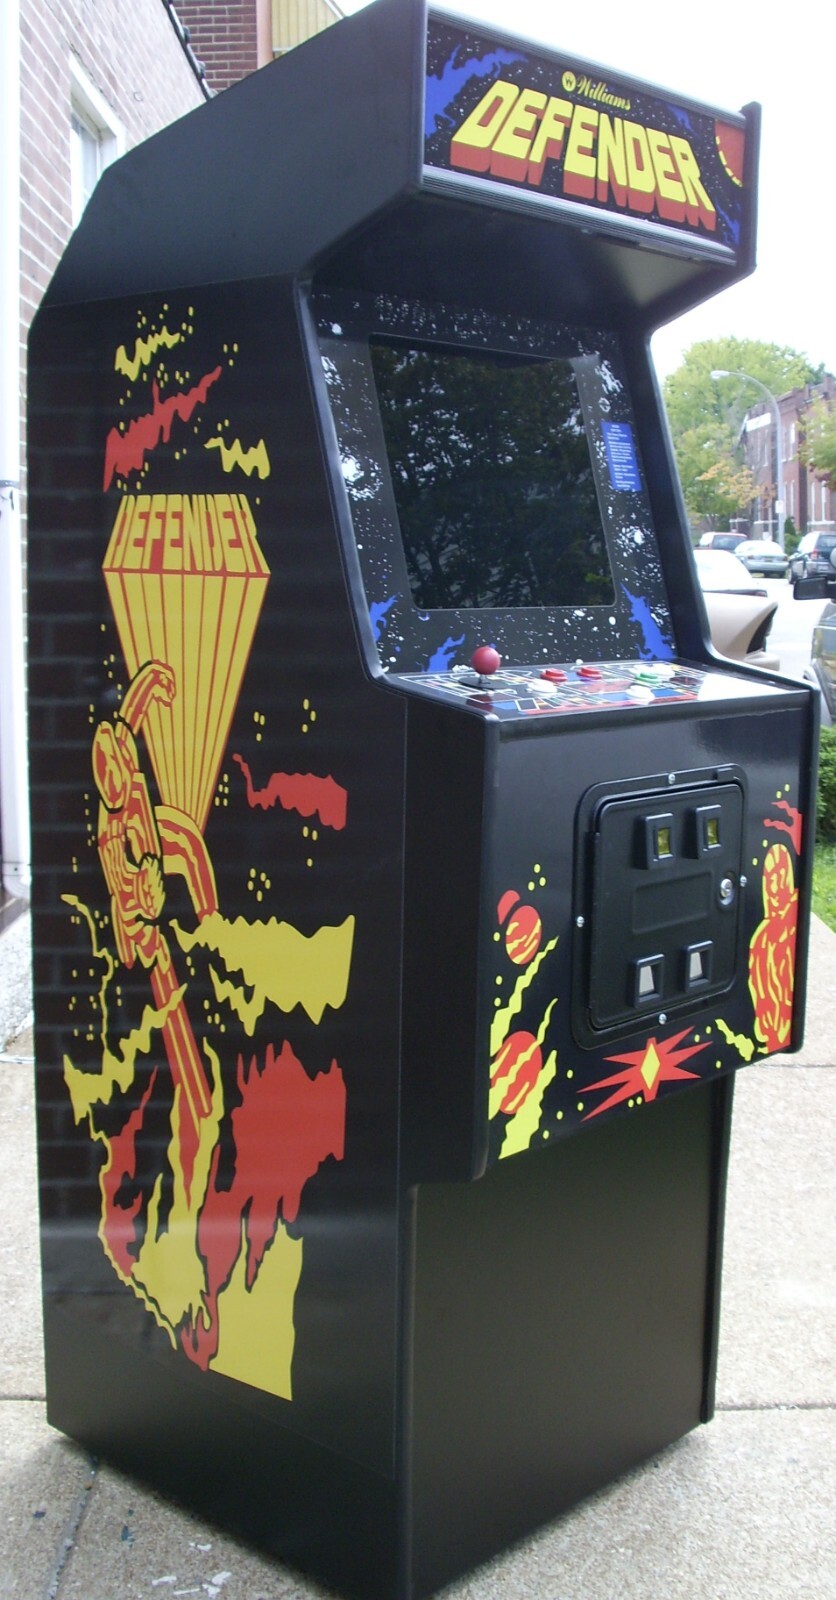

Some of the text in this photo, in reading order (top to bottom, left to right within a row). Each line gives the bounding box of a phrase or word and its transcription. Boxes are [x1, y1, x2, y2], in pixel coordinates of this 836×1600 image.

[577, 75, 631, 111] Williams
[450, 80, 716, 231] DEFENDER
[102, 494, 271, 575] DEFENDER
